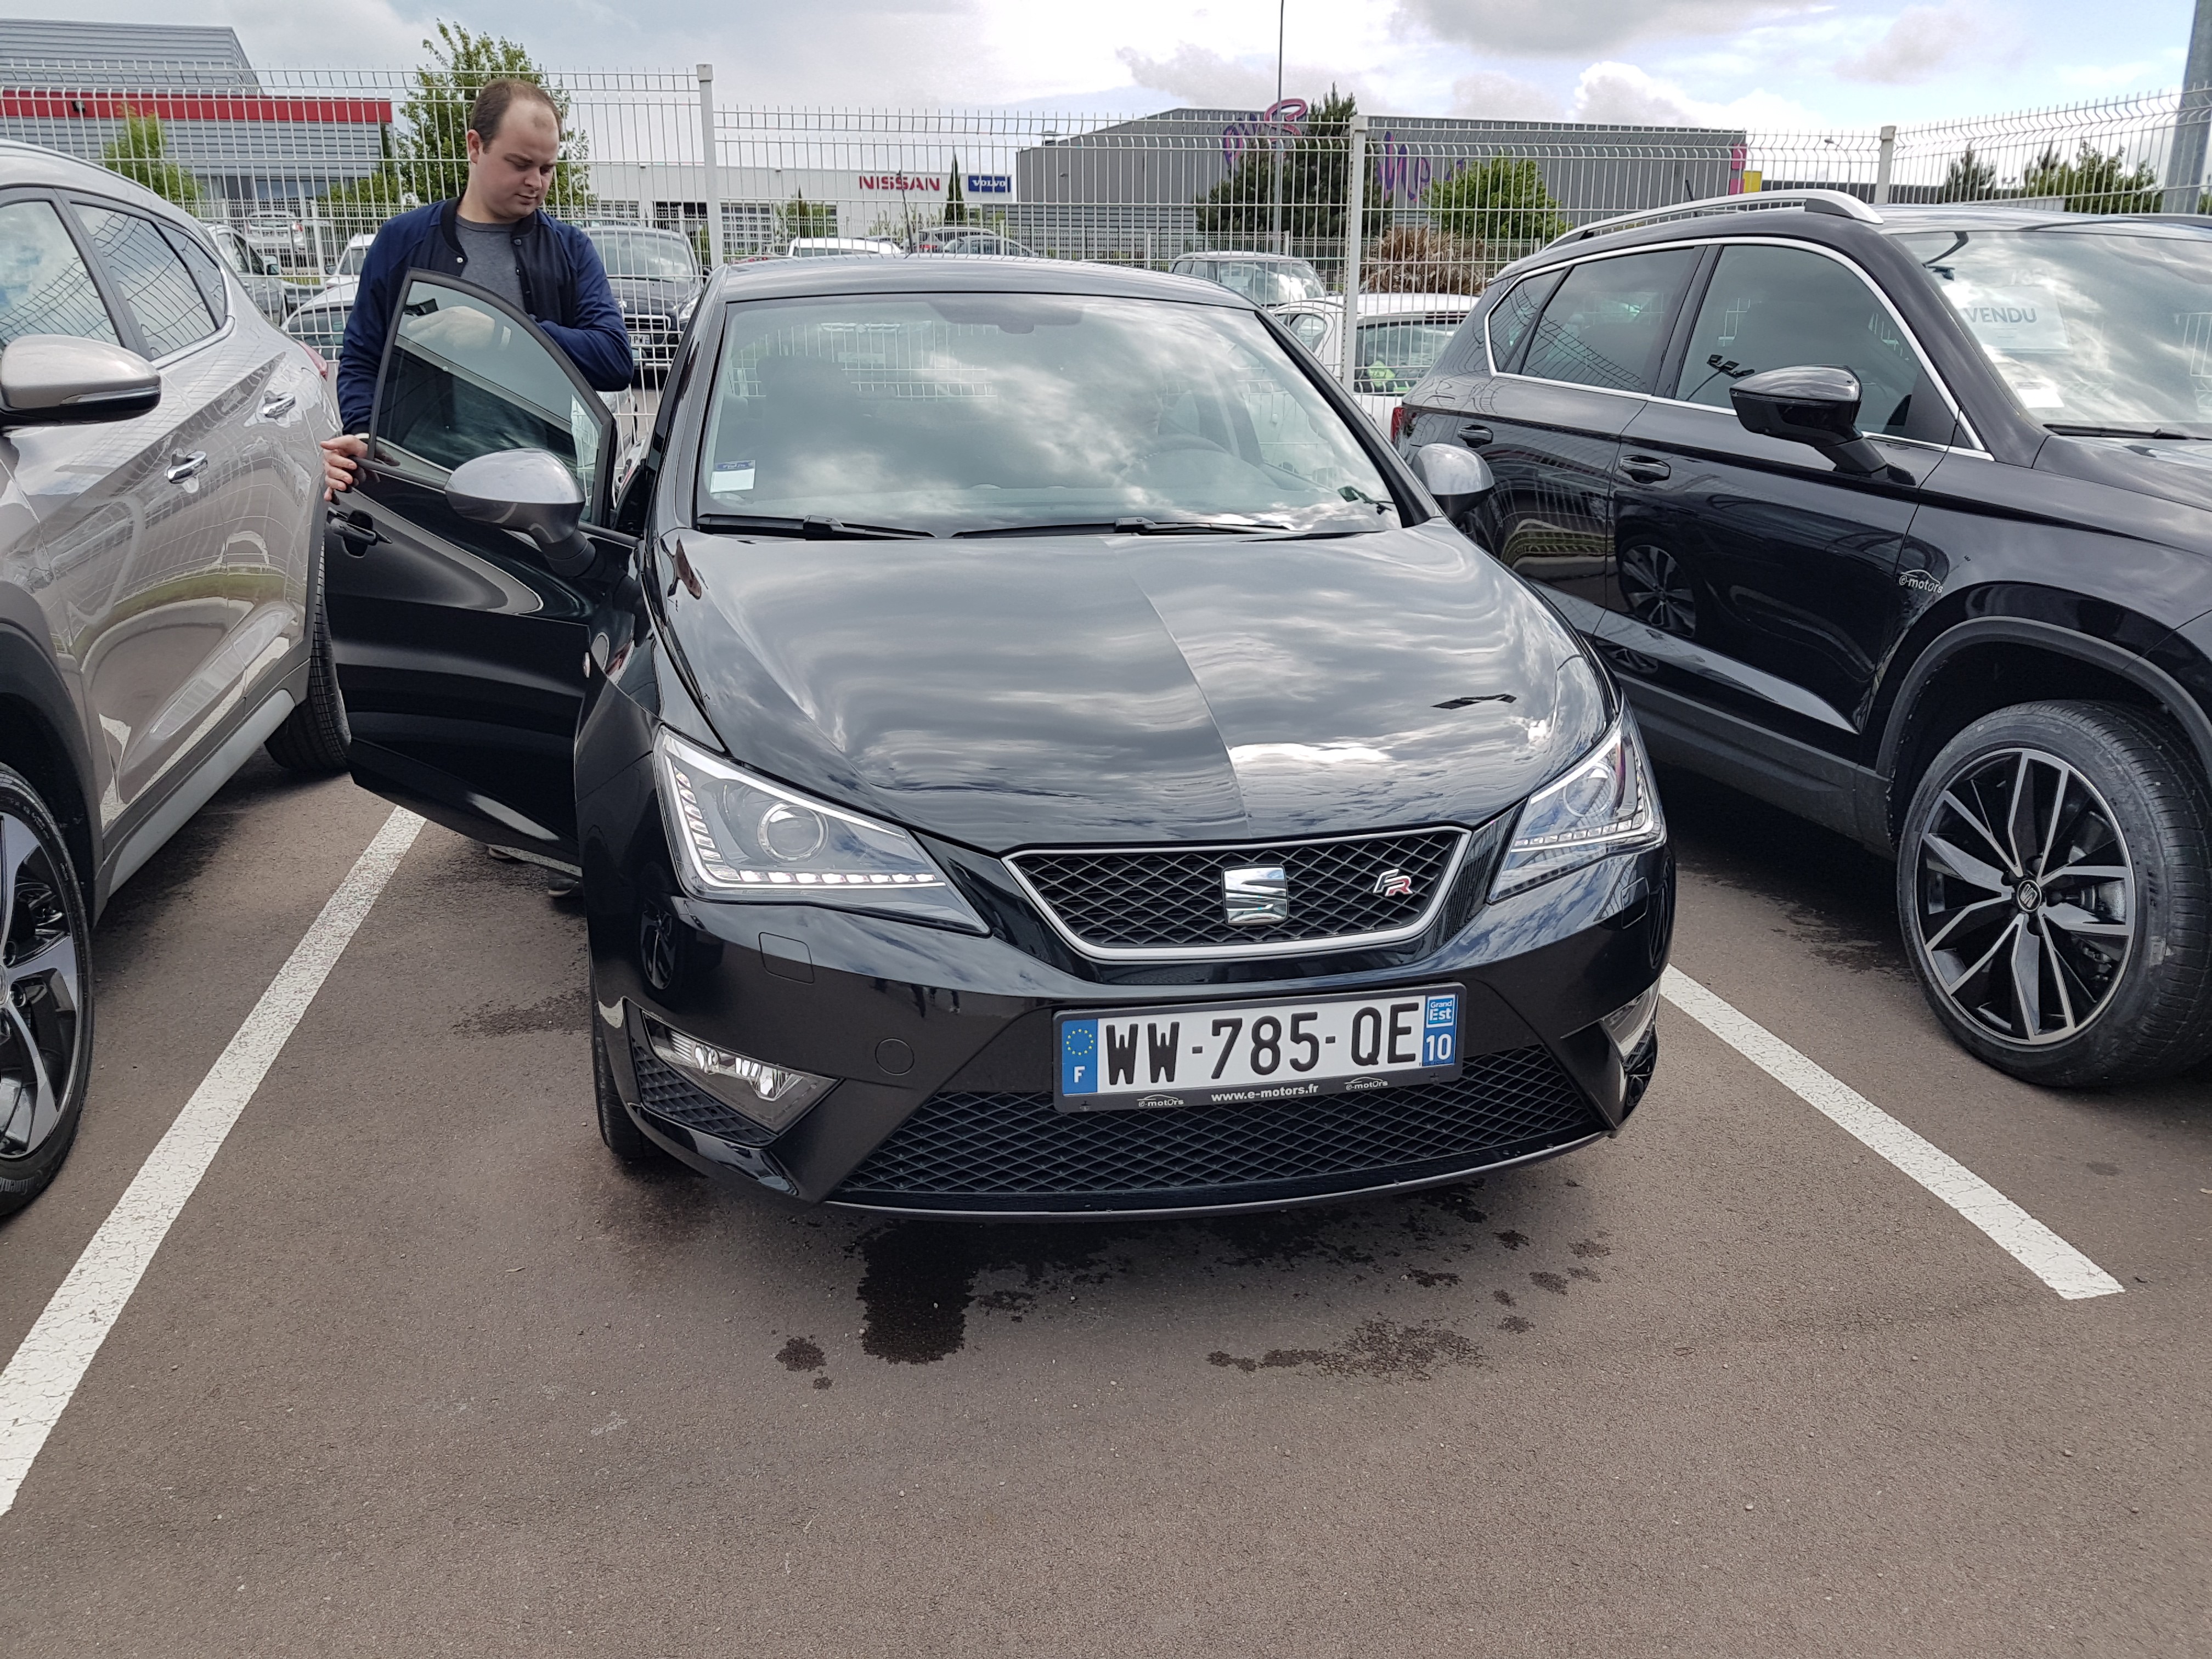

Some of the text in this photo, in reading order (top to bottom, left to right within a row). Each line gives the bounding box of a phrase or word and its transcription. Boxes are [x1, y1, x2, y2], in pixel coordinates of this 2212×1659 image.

[859, 176, 940, 191] NISSAN
[1963, 307, 2037, 323] VENDU
[1373, 868, 1413, 897] FR
[1430, 1000, 1453, 1008] Grand
[1429, 1007, 1452, 1021] Est
[1426, 1034, 1452, 1061] 10
[1074, 1065, 1086, 1083] F
[1211, 1084, 1318, 1103] www.e-motors.fr
